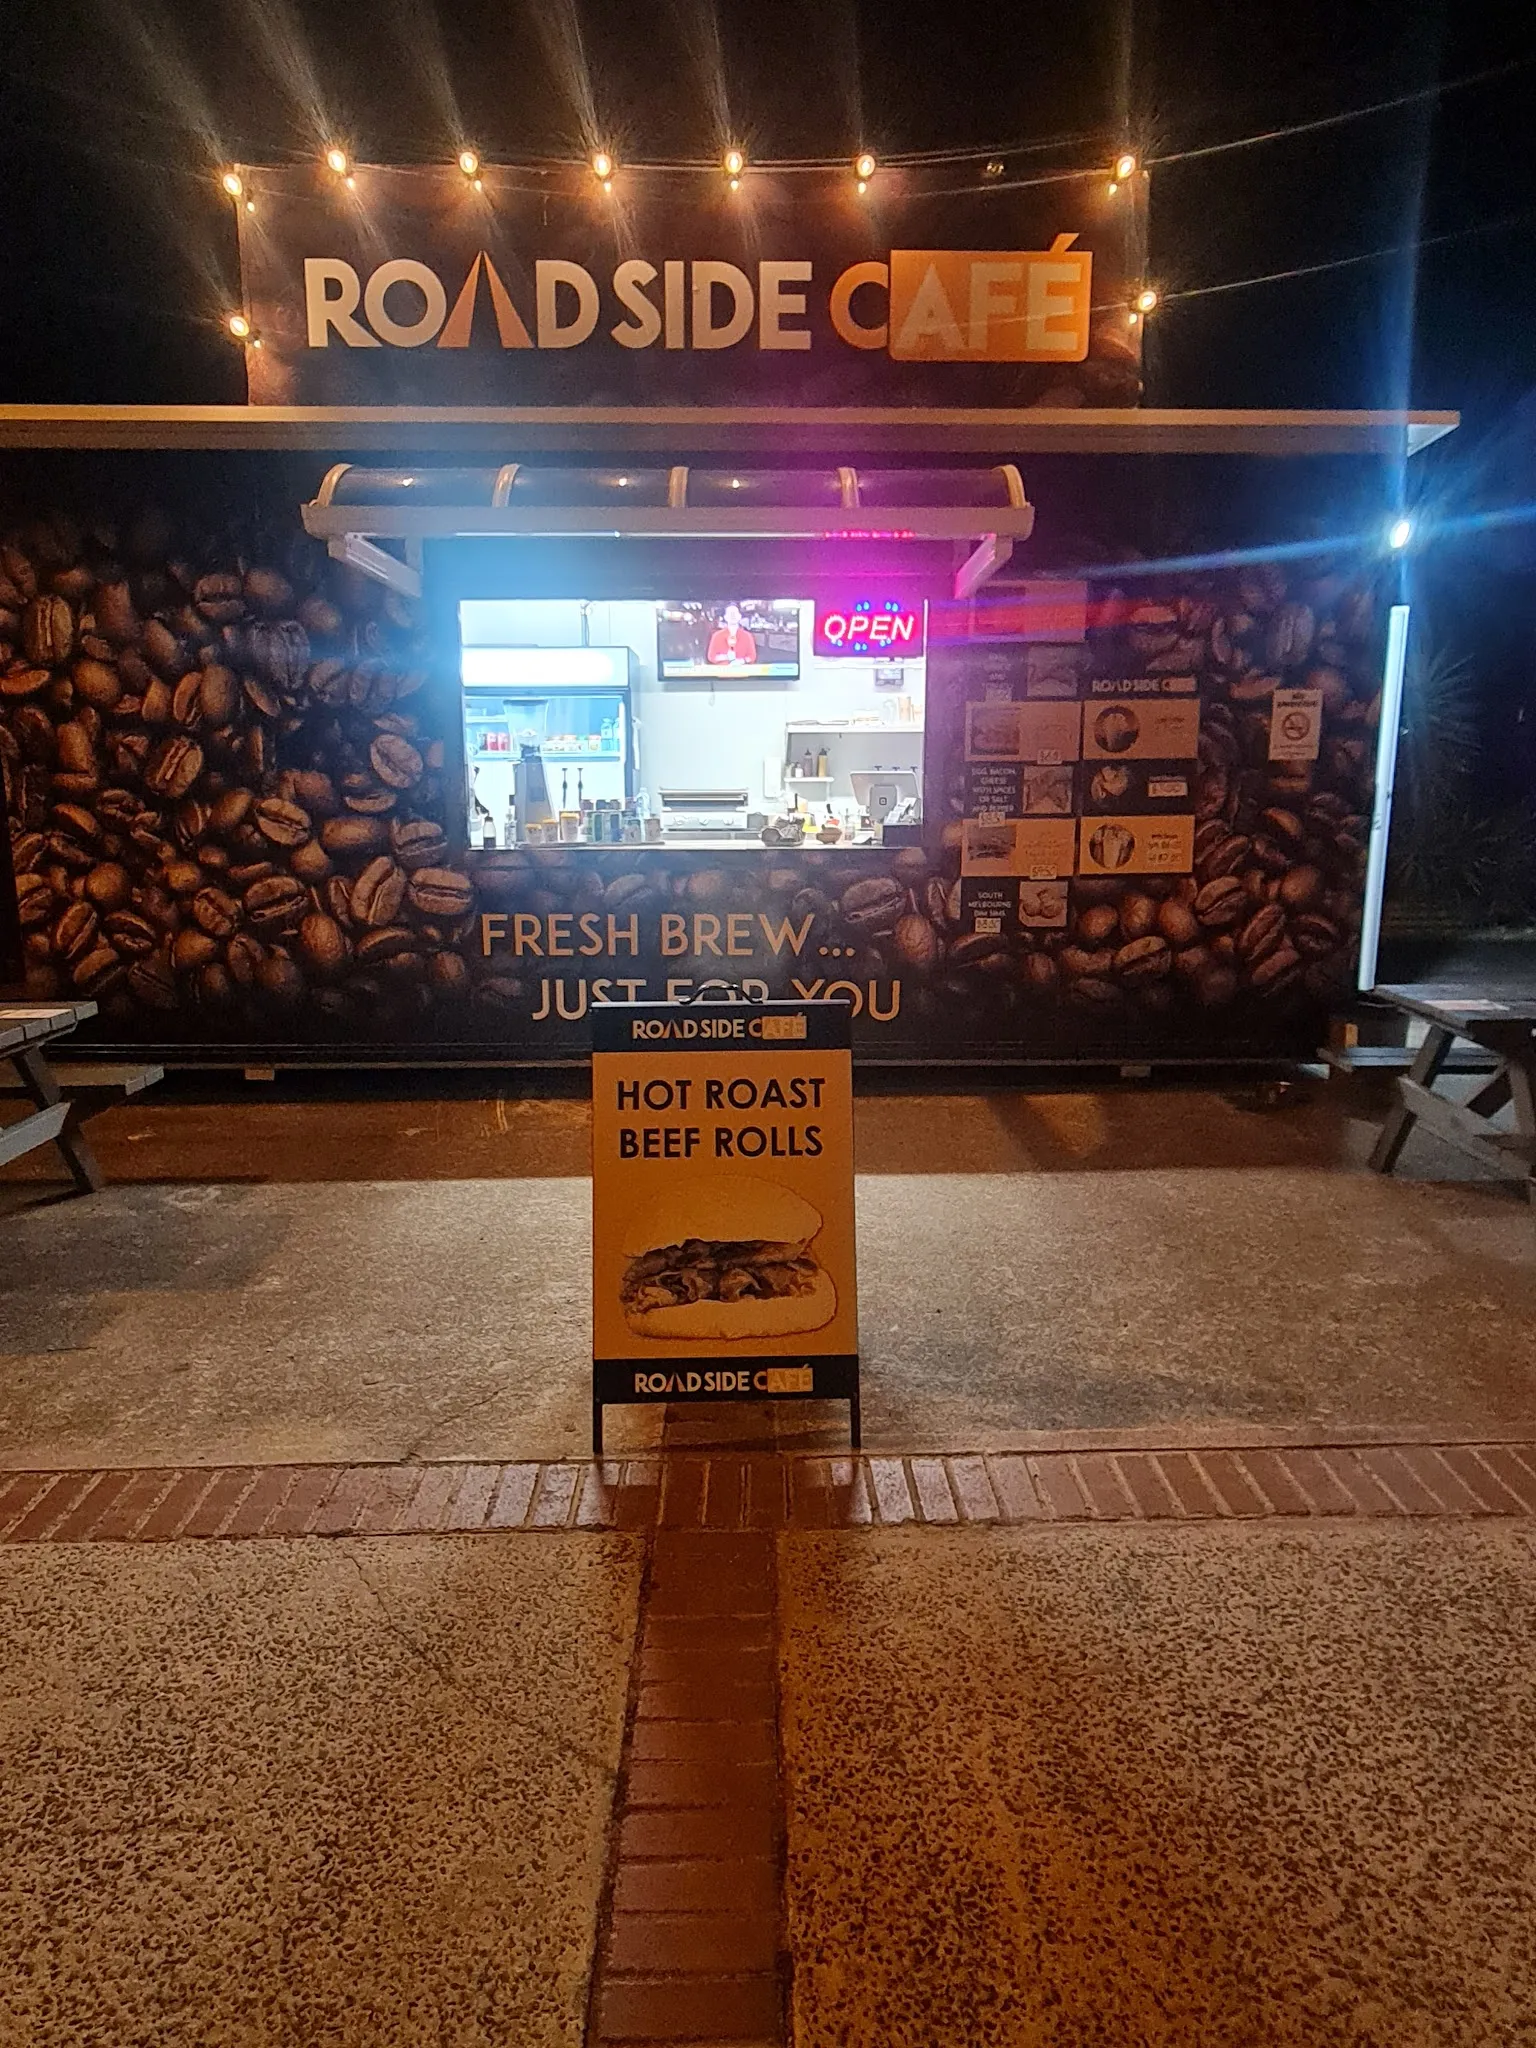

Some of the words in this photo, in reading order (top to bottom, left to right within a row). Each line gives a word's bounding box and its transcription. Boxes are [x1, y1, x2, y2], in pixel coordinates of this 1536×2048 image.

[304, 251, 812, 351] ROADSIDE
[829, 233, 1085, 352] CAFÉ
[823, 614, 915, 643] OPEN
[968, 900, 1012, 909] MELBOURNE
[977, 891, 1003, 899] SOUTH
[481, 912, 639, 957] FRESH
[531, 978, 647, 1021] JUST
[791, 978, 901, 1021] YOU
[632, 1018, 745, 1039] ROADSIDE
[617, 1079, 693, 1110] HOT
[705, 1077, 826, 1109] ROAST
[619, 1128, 701, 1159] BEEF
[715, 1125, 823, 1158] ROLLS
[634, 1371, 750, 1393] ROADSIDE
